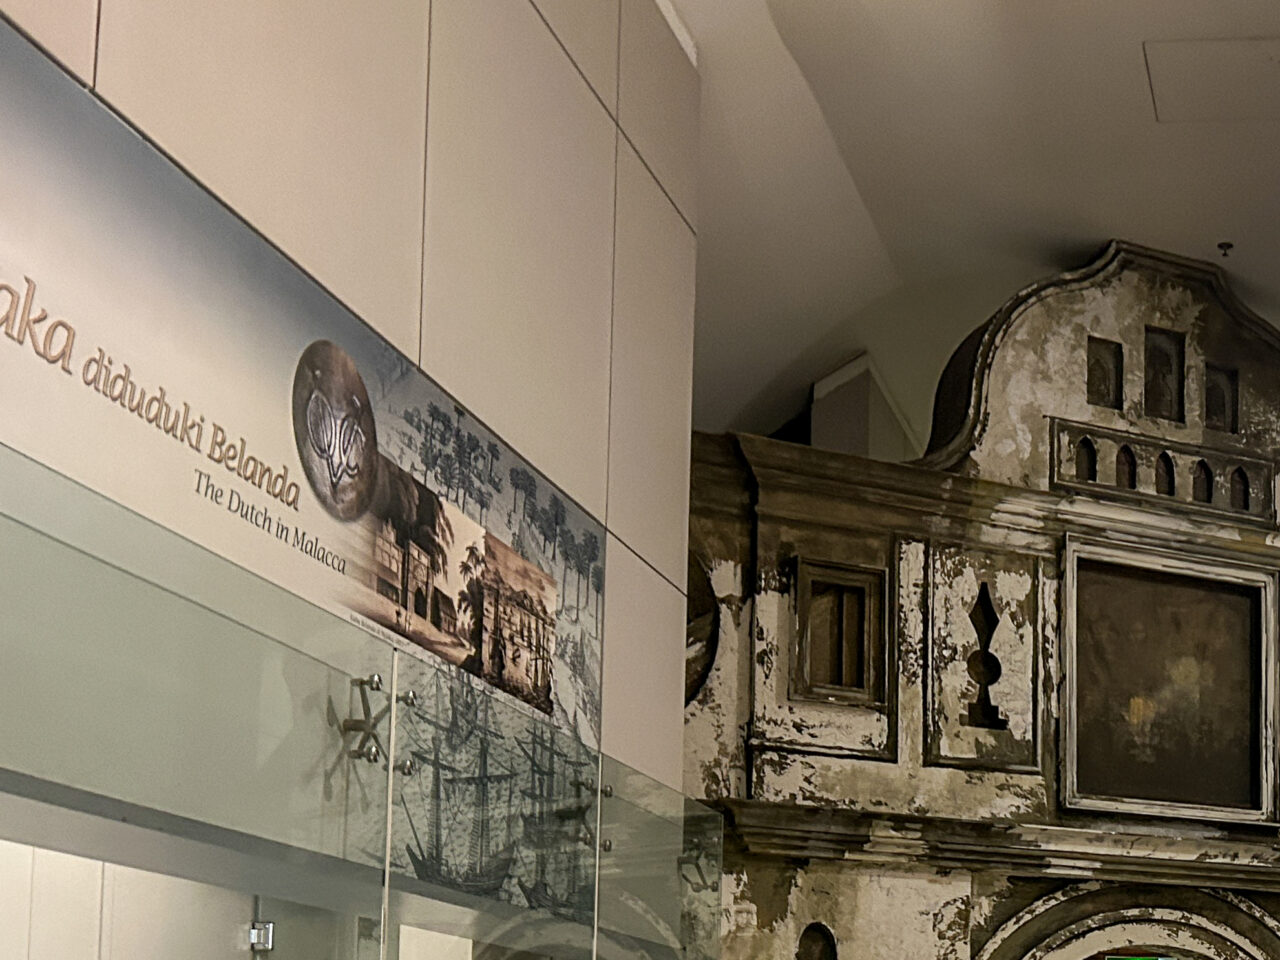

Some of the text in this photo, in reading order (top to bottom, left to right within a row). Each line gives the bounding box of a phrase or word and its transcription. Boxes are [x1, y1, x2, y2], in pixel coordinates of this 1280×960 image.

[81, 347, 205, 454] diduduki
[207, 422, 300, 512] Belanda
[195, 468, 347, 576] The Dutch in Malacca
